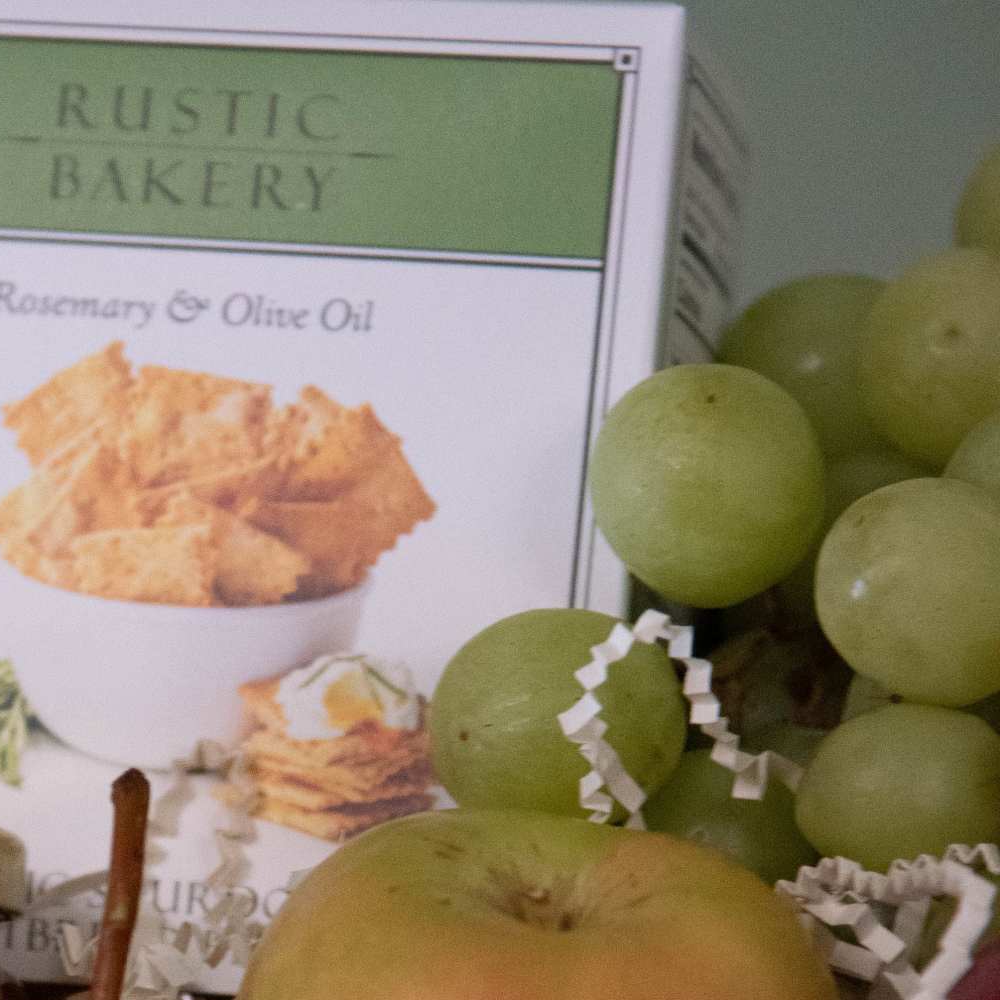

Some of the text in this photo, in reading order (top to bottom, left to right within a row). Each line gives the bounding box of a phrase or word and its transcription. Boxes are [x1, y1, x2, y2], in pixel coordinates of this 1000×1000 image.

[56, 81, 340, 142] RUSTIC
[48, 153, 337, 213] BAKERY
[166, 289, 209, 324] &
[221, 291, 310, 330] Olive
[319, 296, 375, 333] Oil
